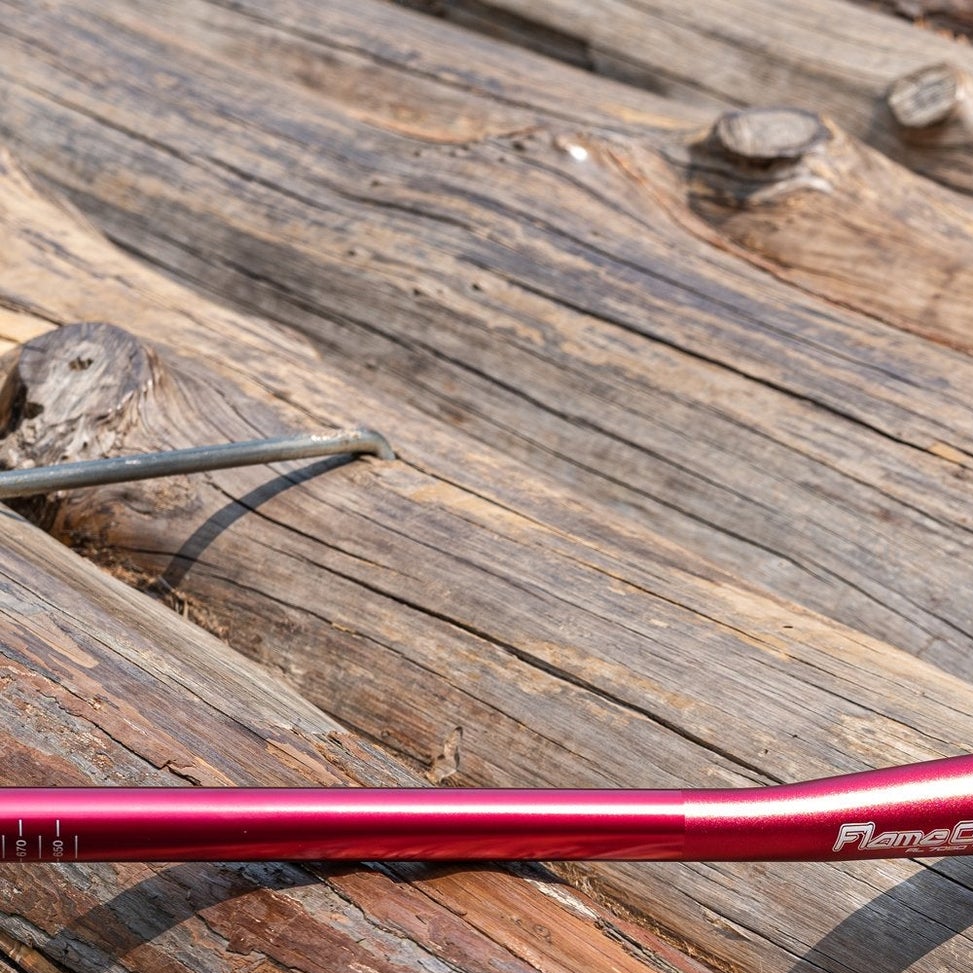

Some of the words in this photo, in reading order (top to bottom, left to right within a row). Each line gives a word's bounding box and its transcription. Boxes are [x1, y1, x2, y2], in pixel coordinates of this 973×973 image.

[832, 821, 950, 852] Flame
[15, 840, 27, 857] 670
[52, 840, 64, 857] 650
